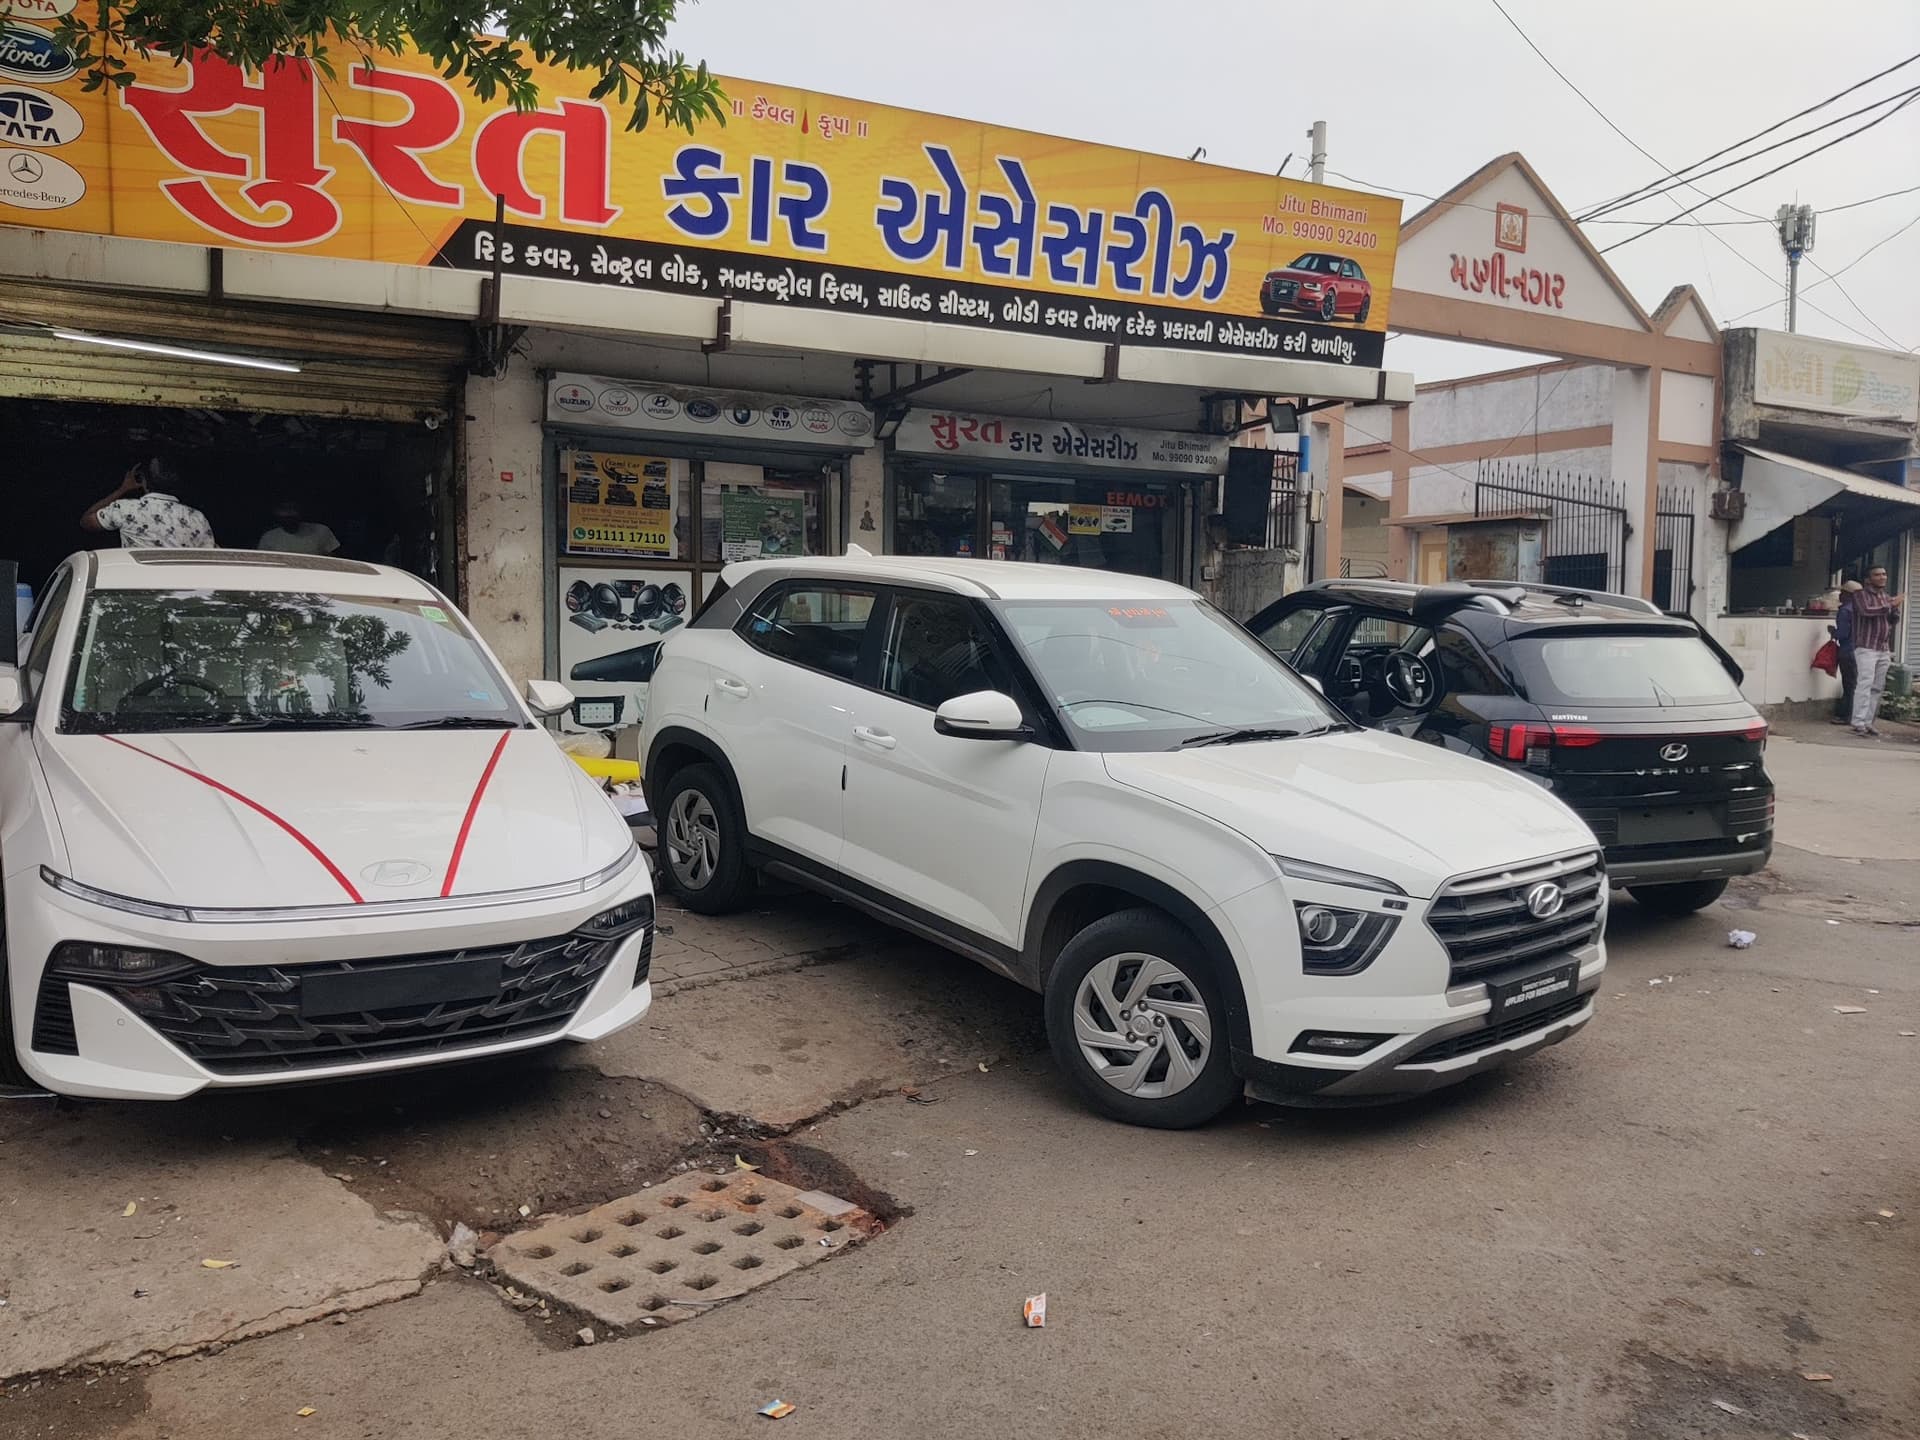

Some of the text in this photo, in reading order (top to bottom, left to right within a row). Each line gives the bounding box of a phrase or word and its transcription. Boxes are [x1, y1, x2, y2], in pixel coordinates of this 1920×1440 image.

[818, 115, 849, 138] કૃપા
[121, 40, 1233, 300] સુરત કાર એસેસરીઝ
[1280, 194, 1368, 223] Jitu Bhimani
[1263, 216, 1377, 248] Mo. 99090 92400
[524, 244, 580, 276] કવર,
[660, 254, 708, 290] લોક,
[878, 284, 932, 312] સાઉન્ડ
[1003, 296, 1039, 324] બોડી
[1045, 307, 1078, 328] કવર
[1084, 305, 1121, 332] તેમજ
[1126, 311, 1157, 337] દરેક
[1283, 331, 1306, 353] કરી
[560, 397, 591, 407] SUZUKI
[606, 404, 632, 412] TOYOTA
[770, 419, 792, 429] TATA
[809, 422, 828, 431] Audi
[930, 414, 1138, 461] સુરત કાર એસેસરીઝ
[1160, 440, 1211, 453] Jitu Bhimani
[1152, 451, 1217, 466] Mo. 99090 92400
[587, 529, 666, 544] 91111 17110
[1635, 766, 1711, 776] VENUE
